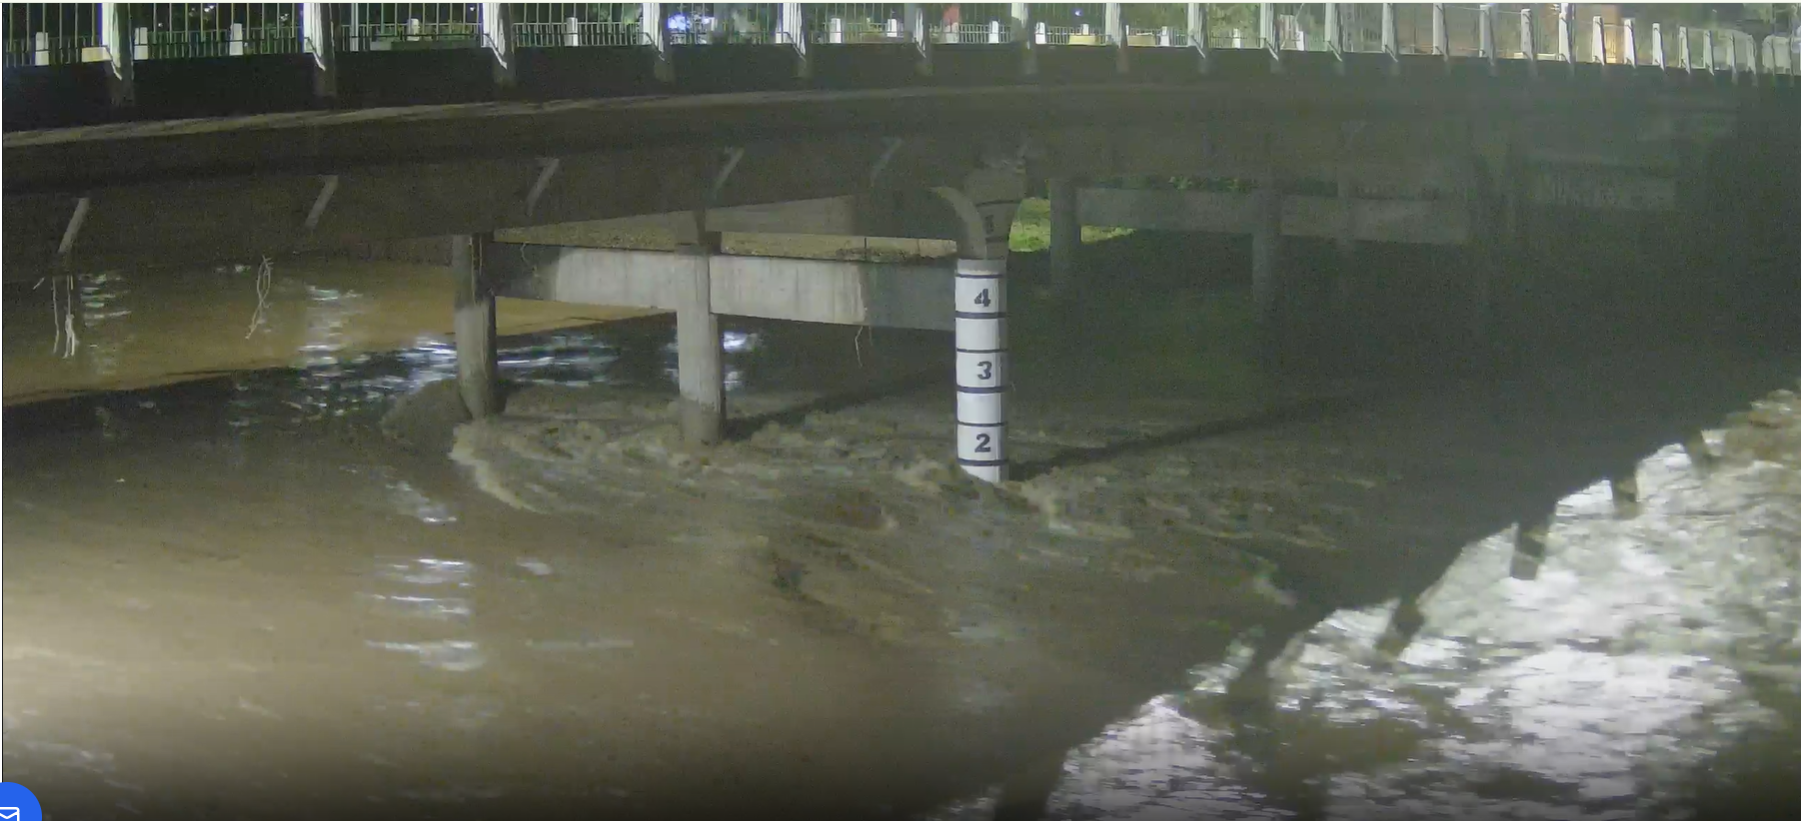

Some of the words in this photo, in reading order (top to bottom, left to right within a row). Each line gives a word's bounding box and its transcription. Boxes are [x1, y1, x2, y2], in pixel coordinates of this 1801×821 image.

[974, 288, 991, 307] 4
[977, 361, 992, 380] 3
[974, 433, 991, 453] 2
